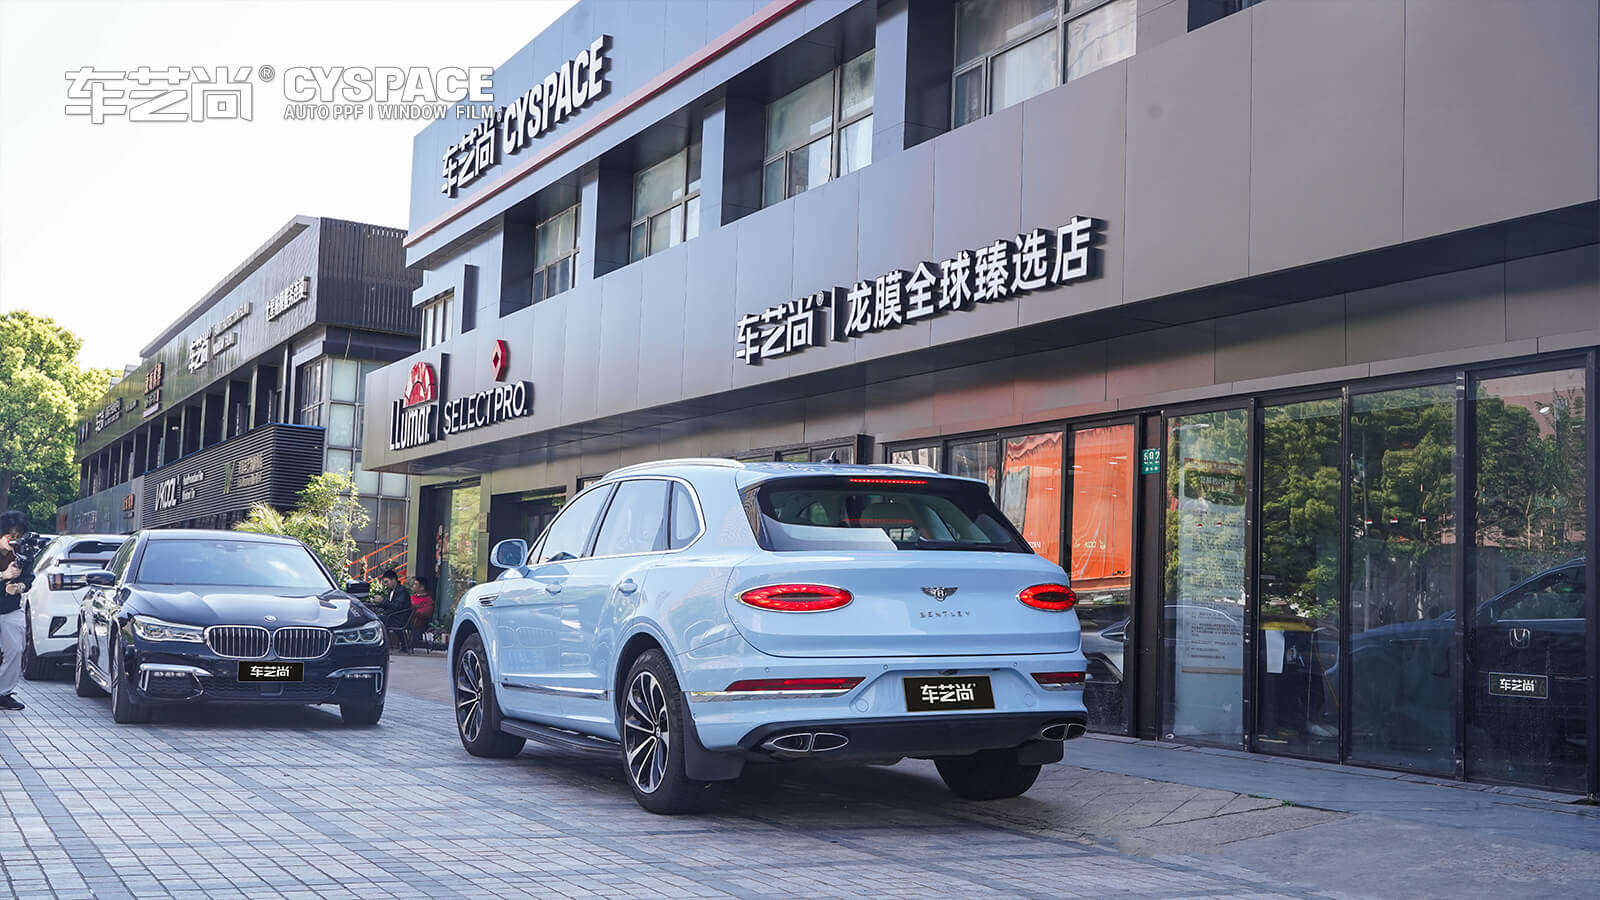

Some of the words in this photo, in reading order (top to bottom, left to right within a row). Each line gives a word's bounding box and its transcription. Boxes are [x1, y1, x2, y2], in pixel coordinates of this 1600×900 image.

[503, 35, 605, 154] CYSPACE
[845, 217, 1092, 335] 龙膜全球臻选店
[250, 666, 290, 677] 车艺尚
[920, 683, 975, 704] 车艺尚
[1500, 678, 1535, 692] 车艺尚
